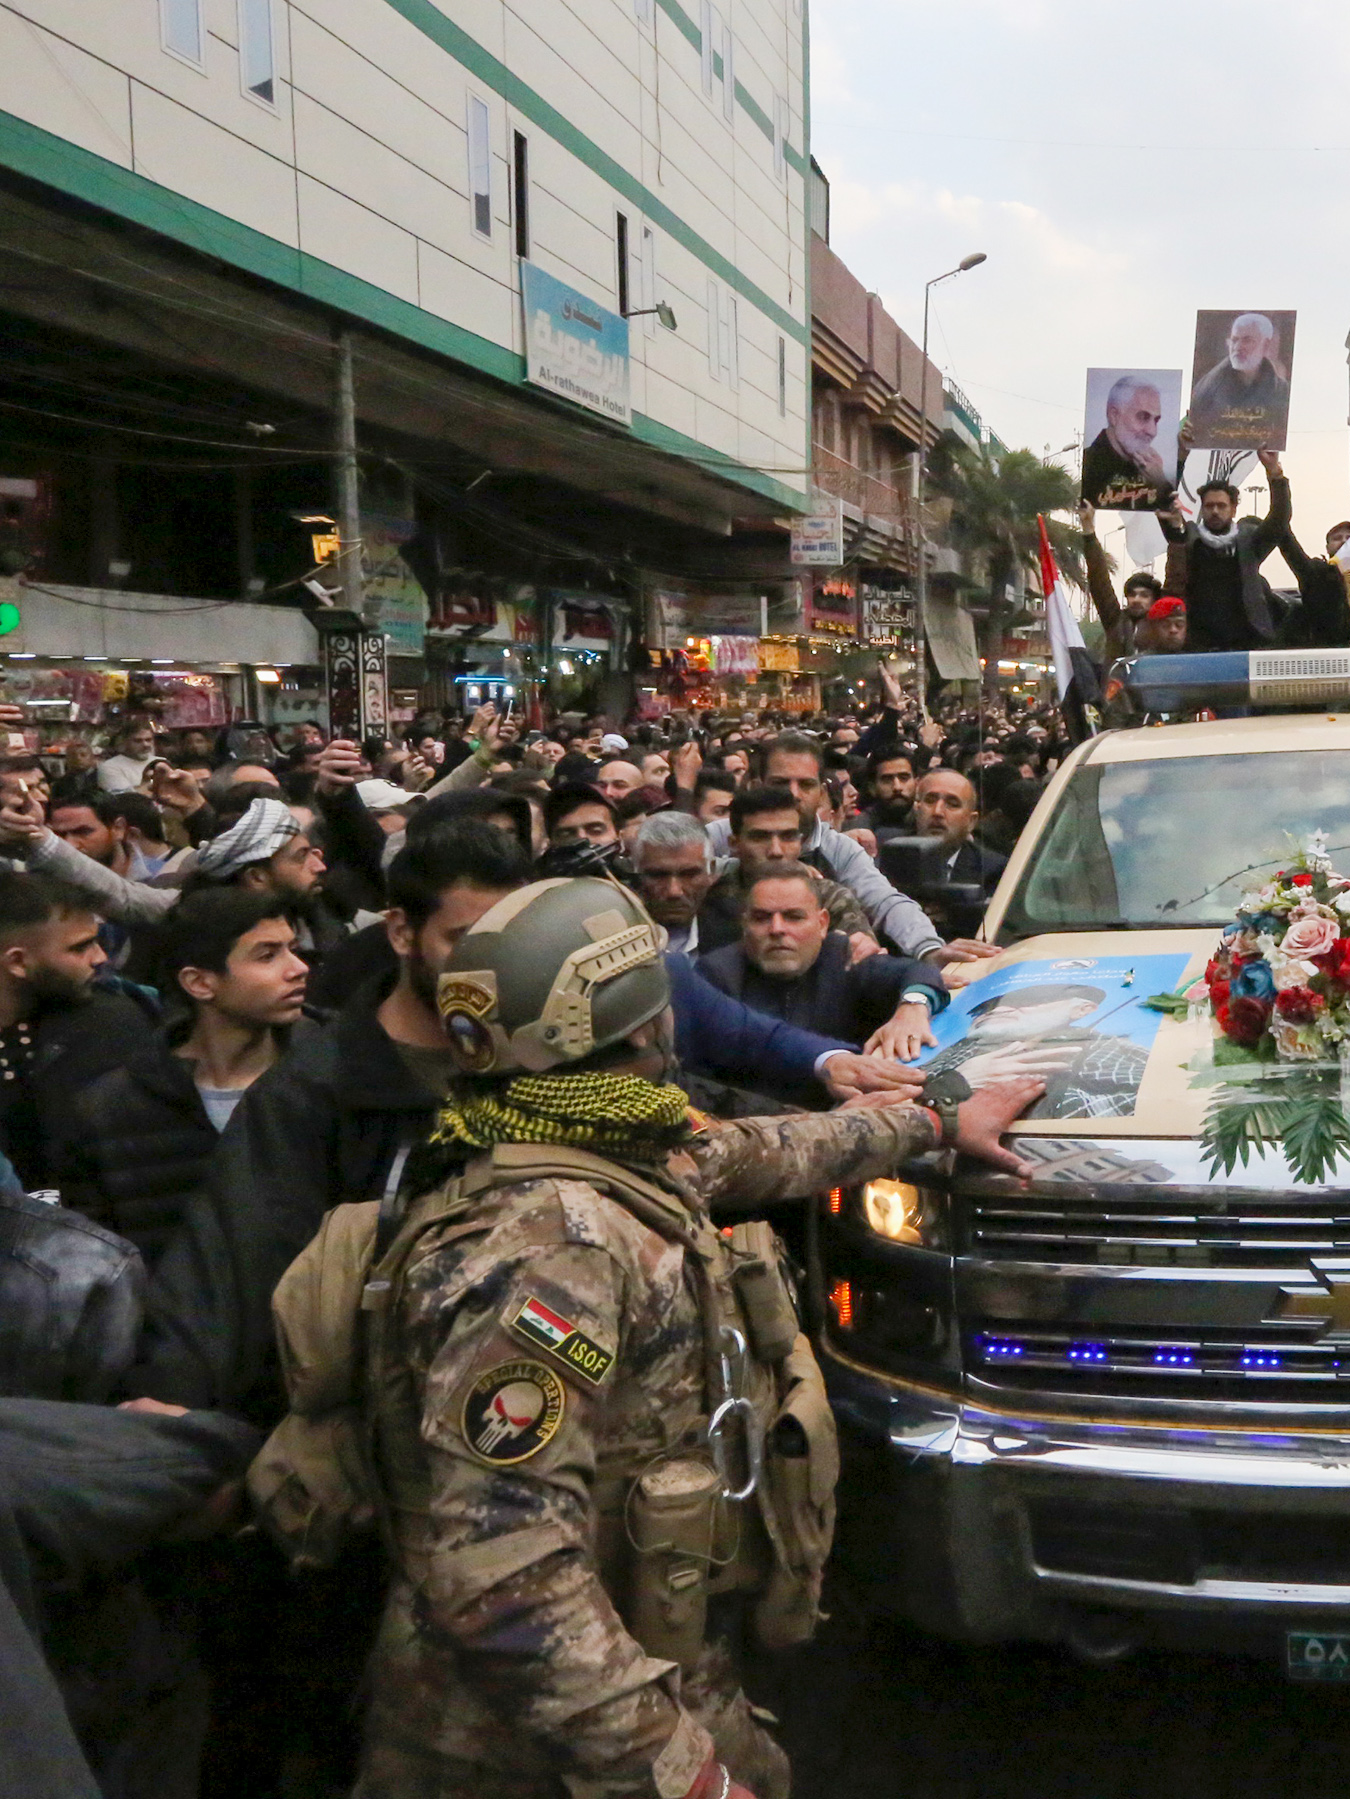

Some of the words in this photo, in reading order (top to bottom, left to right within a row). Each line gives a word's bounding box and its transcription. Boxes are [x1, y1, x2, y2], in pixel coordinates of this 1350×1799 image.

[602, 395, 626, 418] Hotel
[568, 1338, 608, 1373] I.S.O.F
[476, 1365, 531, 1395] SPECIAL
[534, 1369, 561, 1440] OPERTIONS
